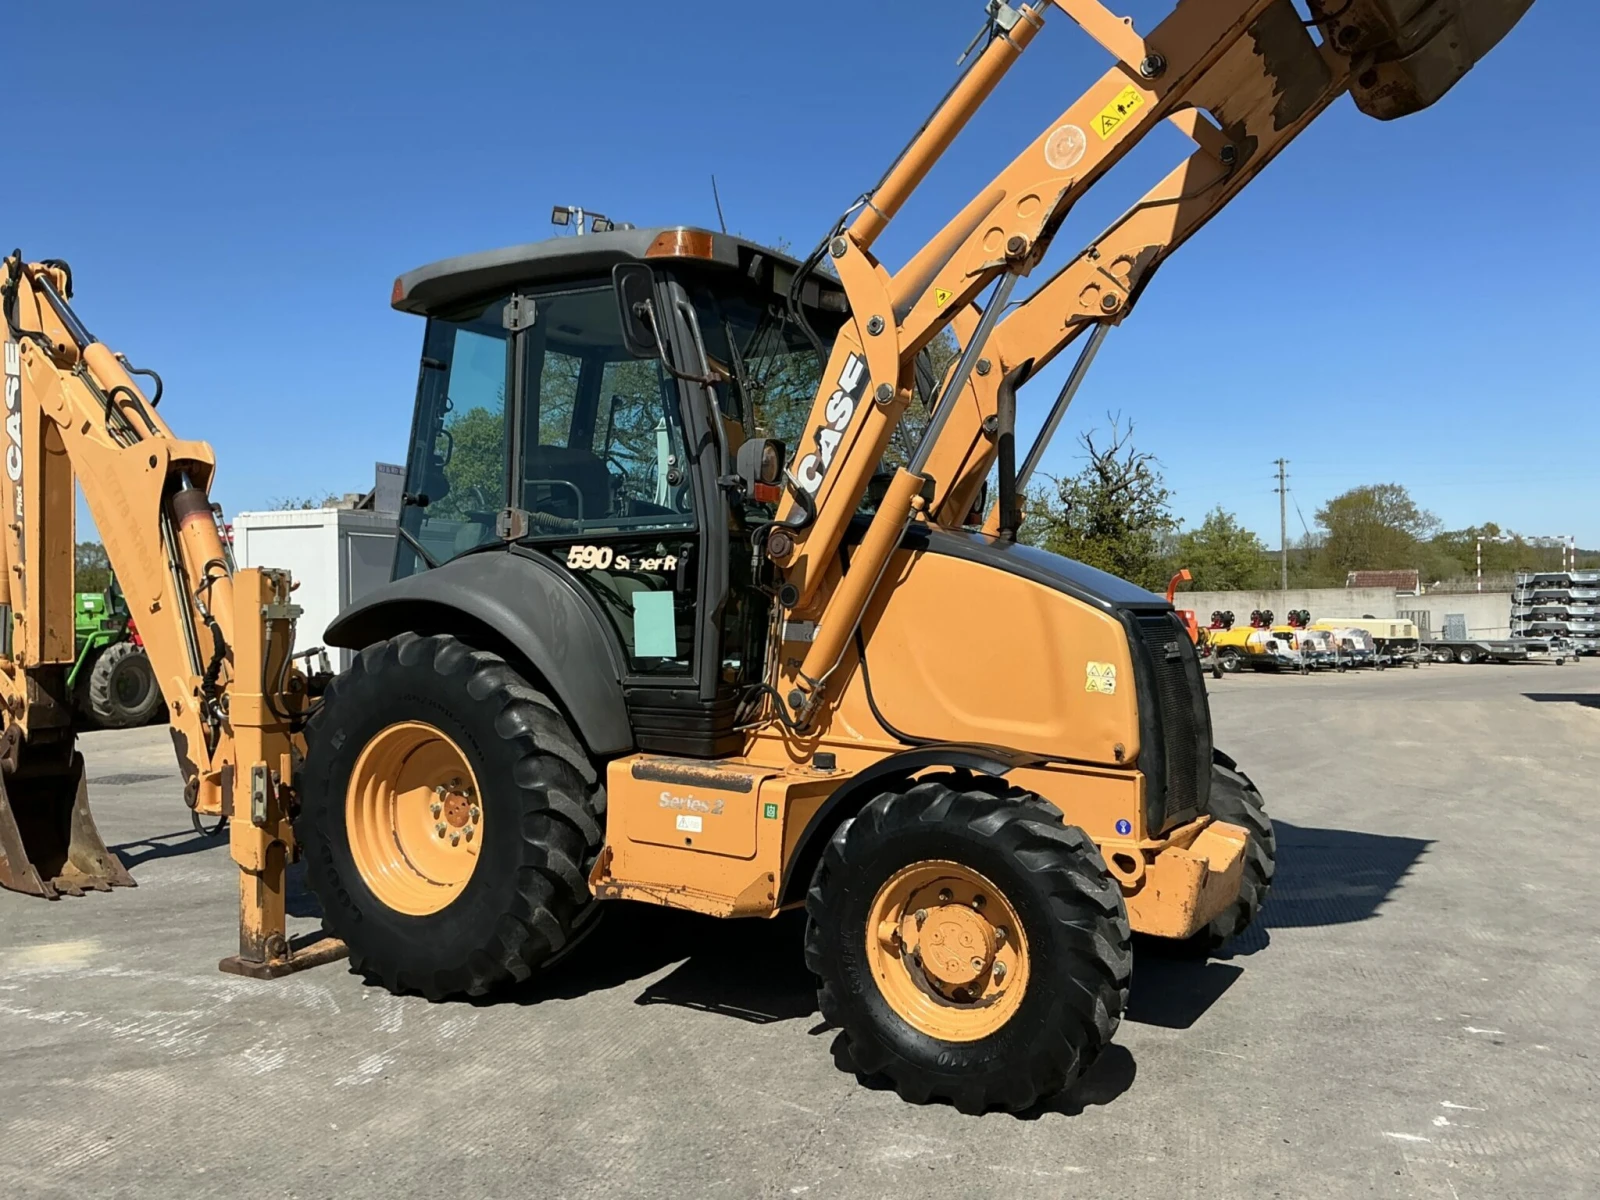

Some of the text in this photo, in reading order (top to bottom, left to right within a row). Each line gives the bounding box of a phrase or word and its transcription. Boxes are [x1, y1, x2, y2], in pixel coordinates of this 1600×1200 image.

[4, 342, 22, 480] CASE
[797, 353, 864, 493] CASE
[566, 545, 613, 569] 590
[658, 791, 724, 815] Series 2
